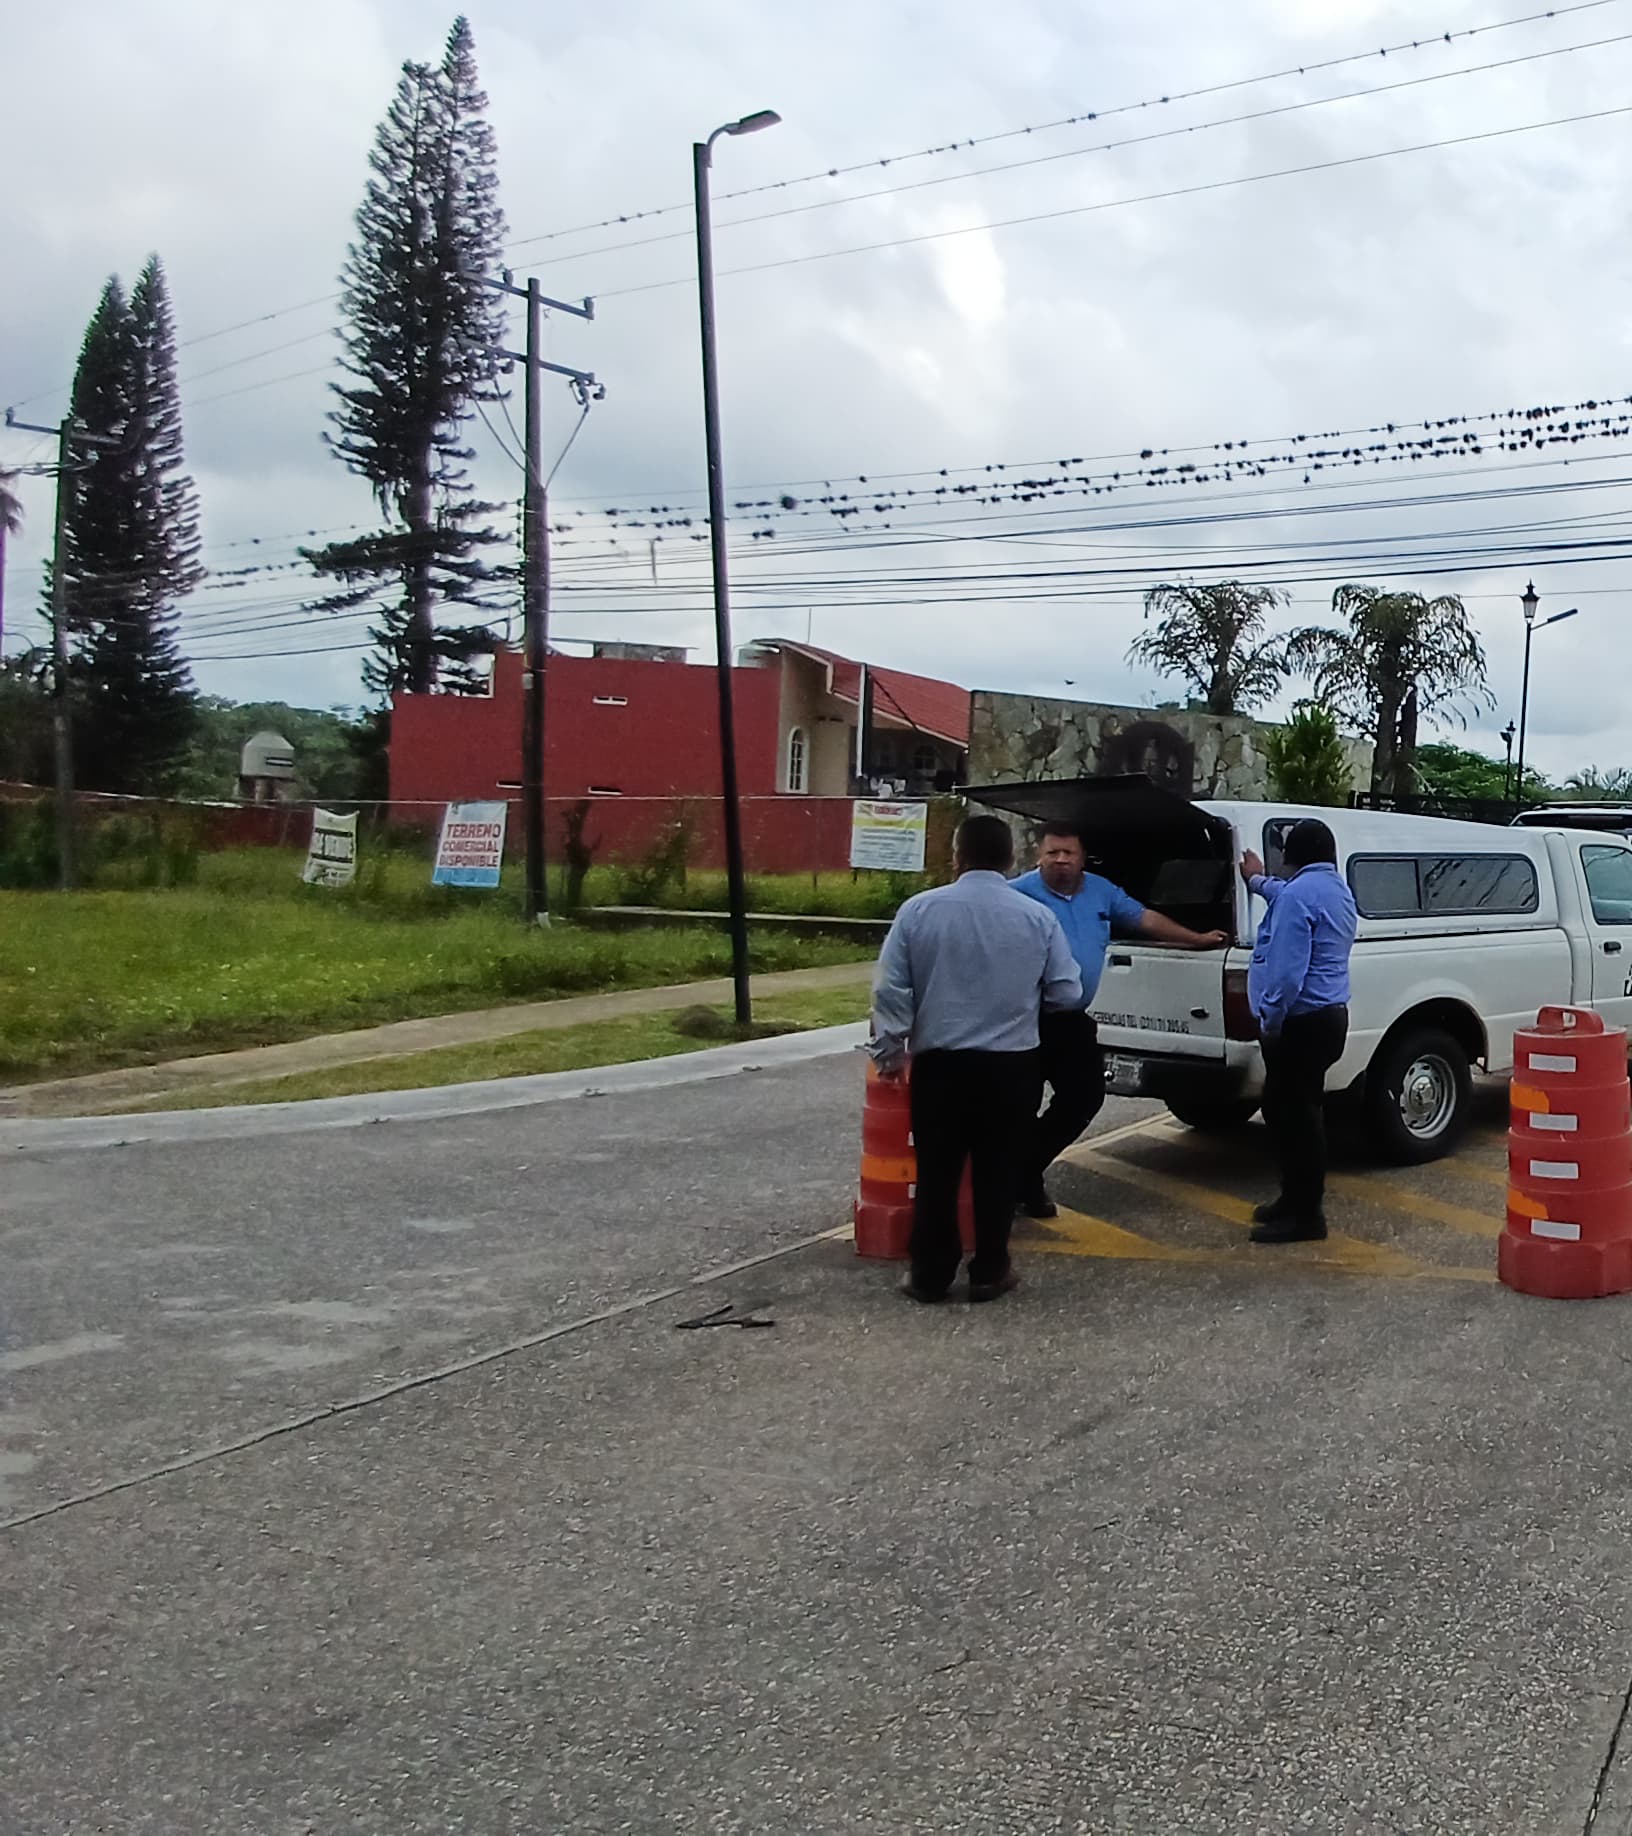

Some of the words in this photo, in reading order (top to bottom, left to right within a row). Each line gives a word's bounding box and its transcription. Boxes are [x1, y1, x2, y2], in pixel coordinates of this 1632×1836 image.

[447, 823, 502, 838] TERRENO
[442, 839, 500, 853] COMERCIAL
[439, 854, 499, 868] DISPONIBLE
